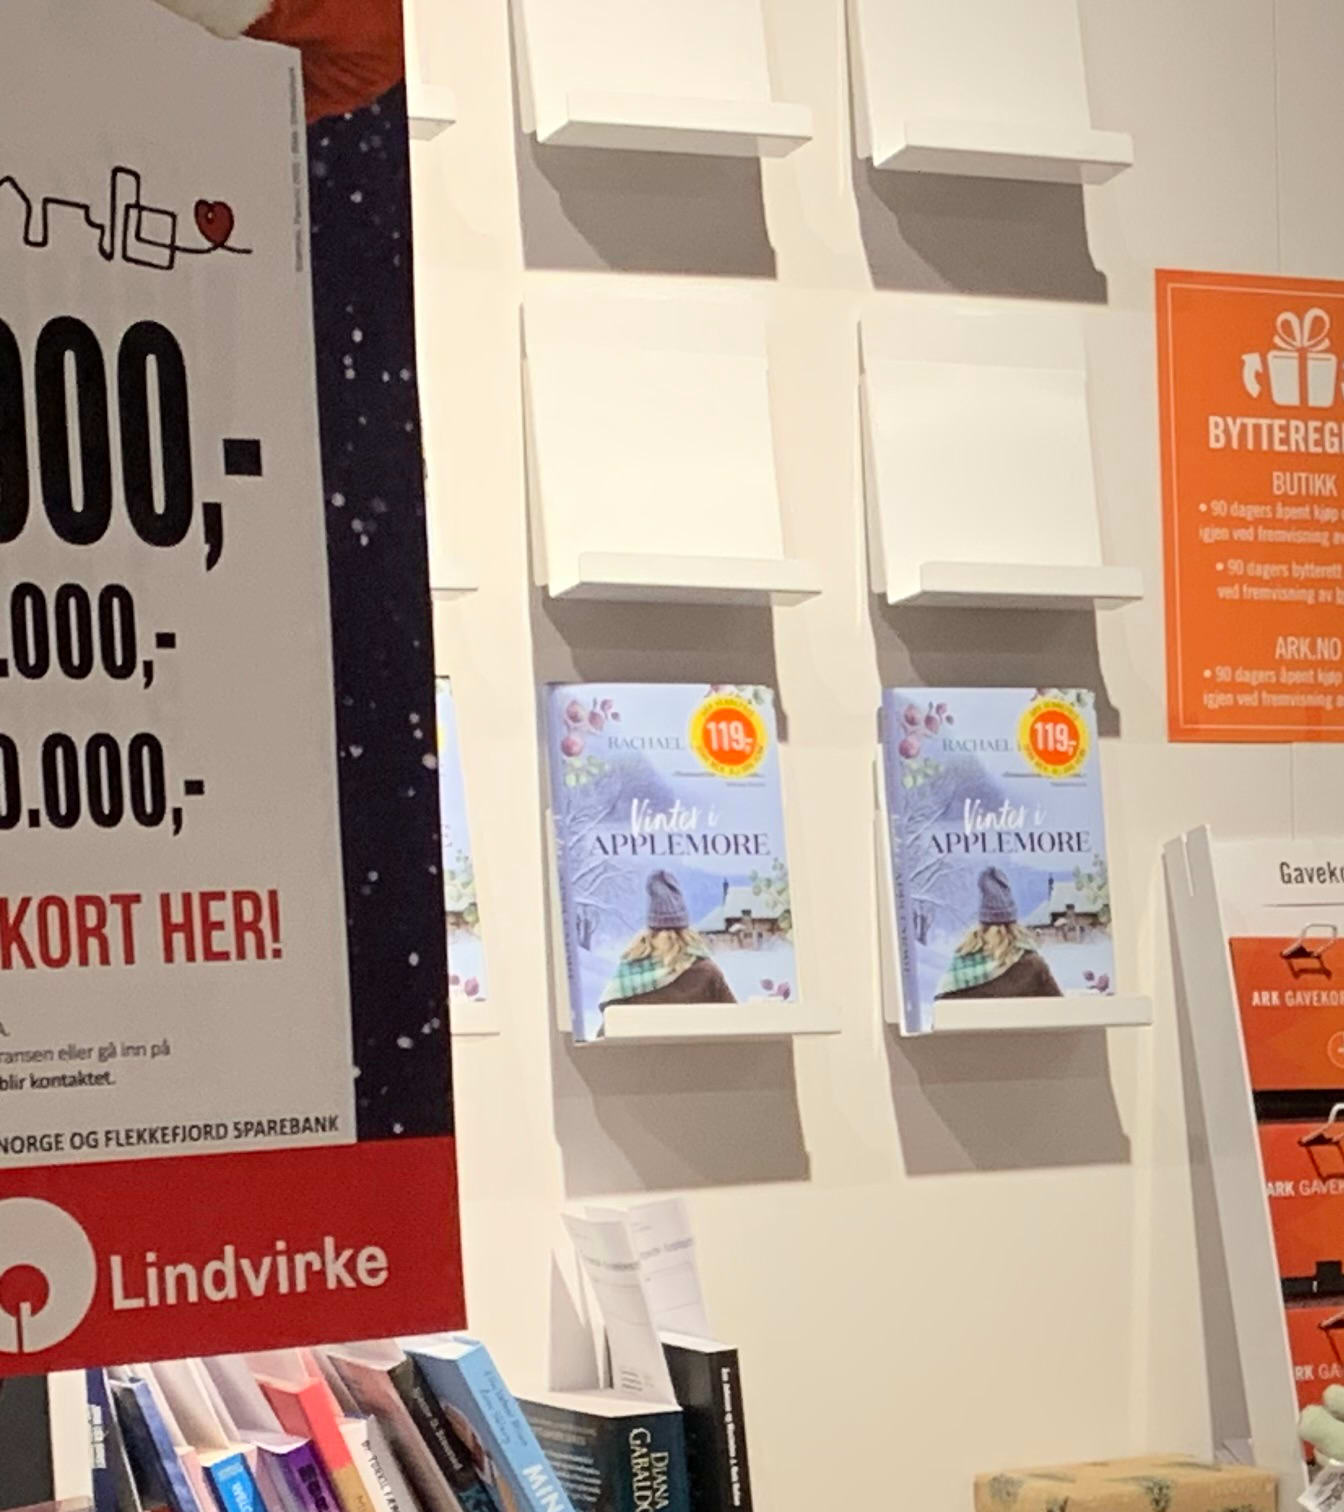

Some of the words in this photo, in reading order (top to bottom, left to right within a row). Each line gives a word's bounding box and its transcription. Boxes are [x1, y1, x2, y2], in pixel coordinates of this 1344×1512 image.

[1272, 471, 1338, 497] BUTIKK
[1210, 500, 1228, 518] 90
[1230, 501, 1273, 521] dagers
[1227, 559, 1245, 576] 90
[1247, 561, 1290, 580] dagers
[1217, 584, 1240, 599] ved
[1275, 636, 1343, 661] ARK.NO
[1215, 666, 1233, 682] 90
[1235, 667, 1277, 686] dagers
[608, 736, 683, 750] RACHAEL
[706, 720, 753, 755] 119,-
[942, 738, 1013, 752] RACHAEL
[1034, 721, 1077, 756] 119,-
[631, 798, 698, 836] Vinter
[963, 798, 1025, 836] Vinter
[590, 832, 772, 856] APPLEMORE
[927, 831, 1092, 855] APPLEMORE
[0, 893, 141, 970] KORT
[160, 889, 283, 964] HER!
[1251, 989, 1280, 1007] ARK
[58, 1042, 93, 1061] eller
[97, 1040, 117, 1063] gå
[121, 1041, 147, 1058] inn
[151, 1039, 171, 1059] på
[0, 1076, 25, 1092] blir
[30, 1070, 116, 1090] kontaktet.
[69, 1131, 99, 1149] OG
[104, 1122, 228, 1149] FLEKKEFJORD
[233, 1115, 339, 1140] SPAREBANK
[110, 1236, 389, 1311] Lindvirke
[650, 1451, 670, 1510] DIANA
